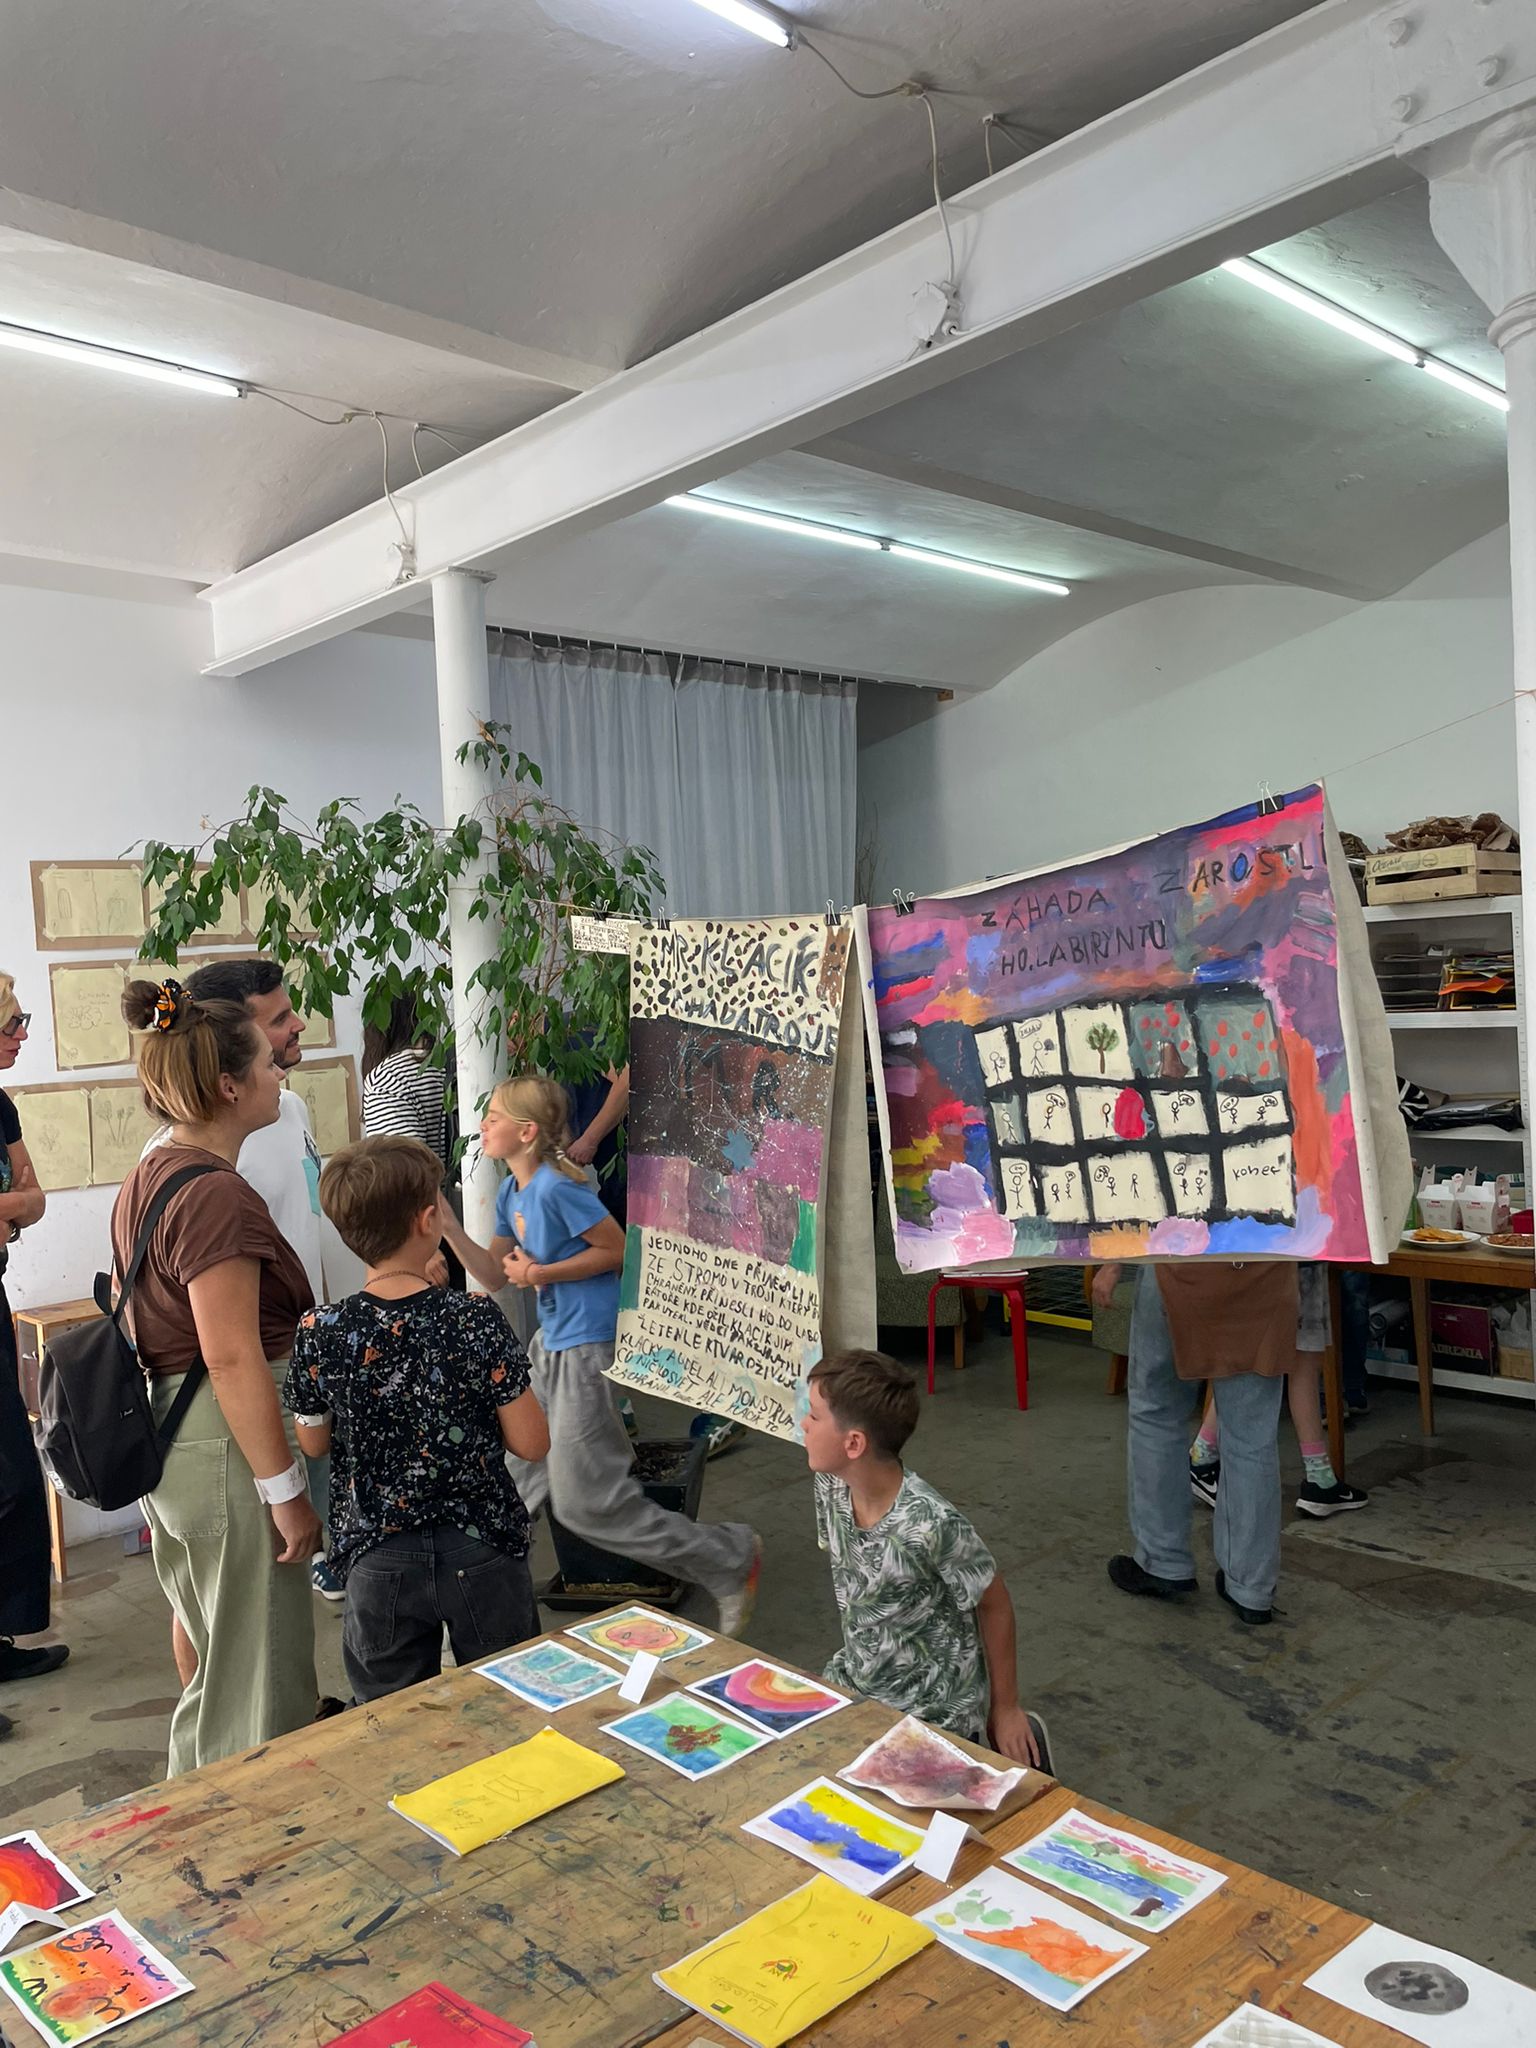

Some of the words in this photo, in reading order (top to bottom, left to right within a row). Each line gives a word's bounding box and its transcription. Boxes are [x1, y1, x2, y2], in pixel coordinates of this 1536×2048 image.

[648, 1236, 708, 1262] JEDNOHO
[714, 1256, 738, 1270] DNE
[648, 1253, 666, 1273] ZE
[732, 1278, 740, 1289] V
[744, 1279, 775, 1304] TROJI
[643, 1298, 661, 1310] PAK
[683, 1299, 705, 1315] KDE
[773, 1335, 794, 1353] JIM
[617, 1347, 634, 1364] CO
[698, 1390, 726, 1409] ALE
